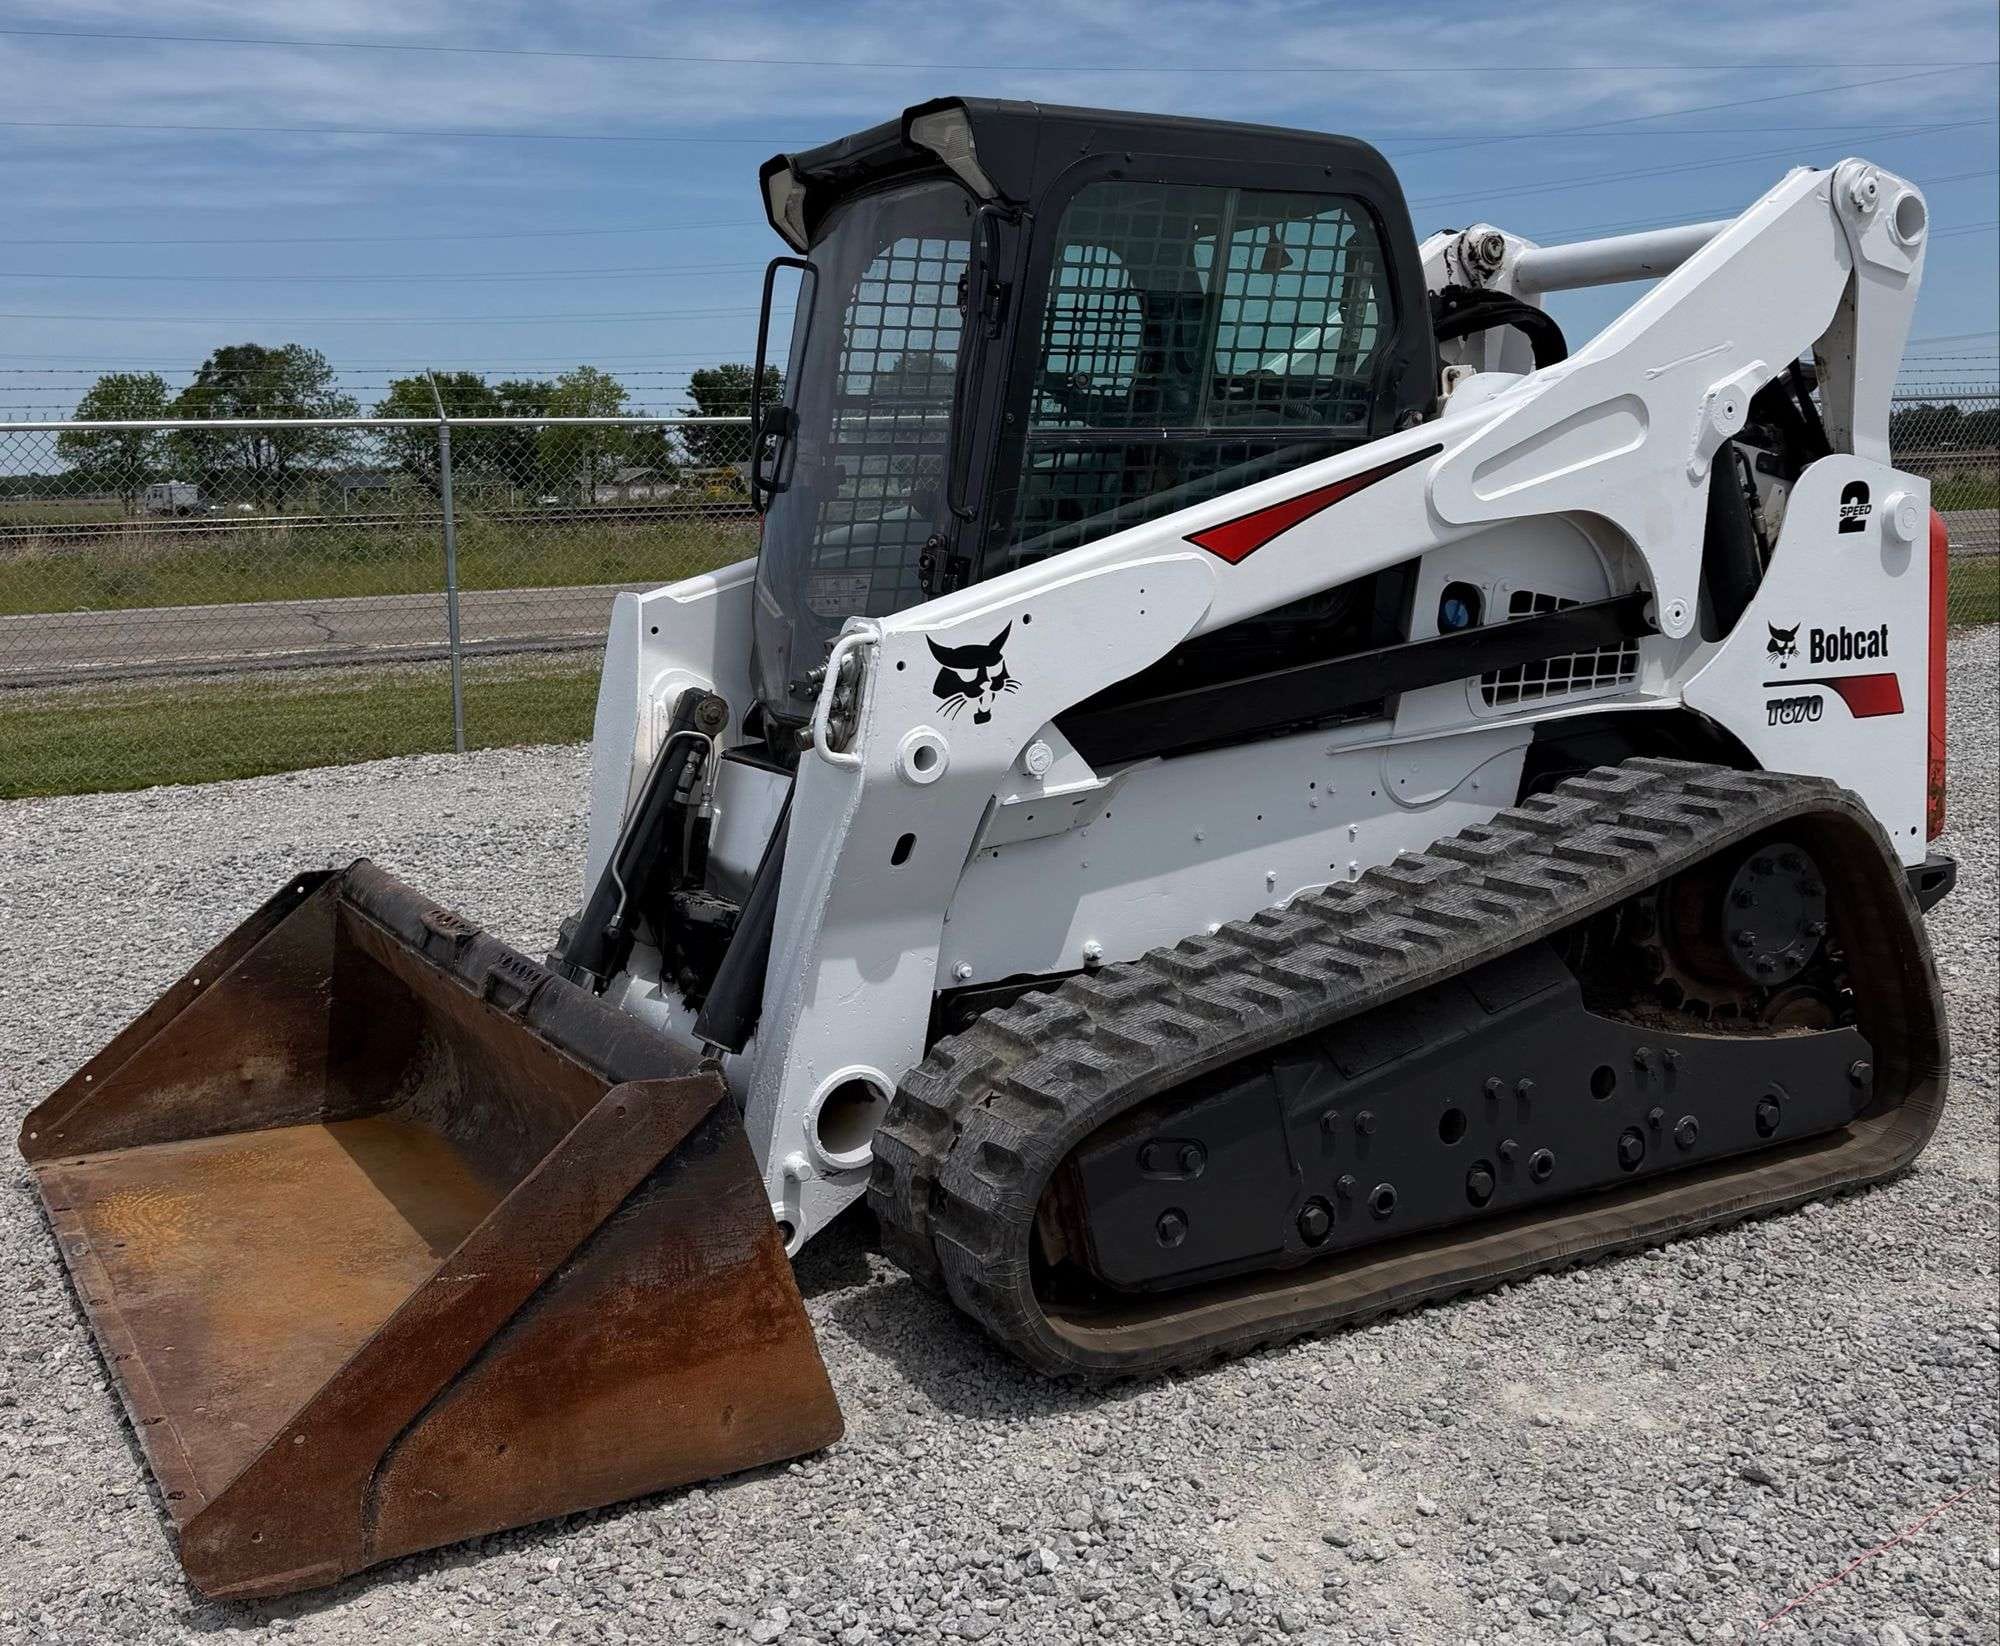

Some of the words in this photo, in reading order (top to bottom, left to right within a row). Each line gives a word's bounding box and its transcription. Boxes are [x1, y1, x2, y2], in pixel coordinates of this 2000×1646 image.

[1838, 480, 1870, 534] 2
[1840, 504, 1872, 517] SPEED
[1810, 624, 1888, 664] Bobcat
[1766, 695, 1824, 726] T870
